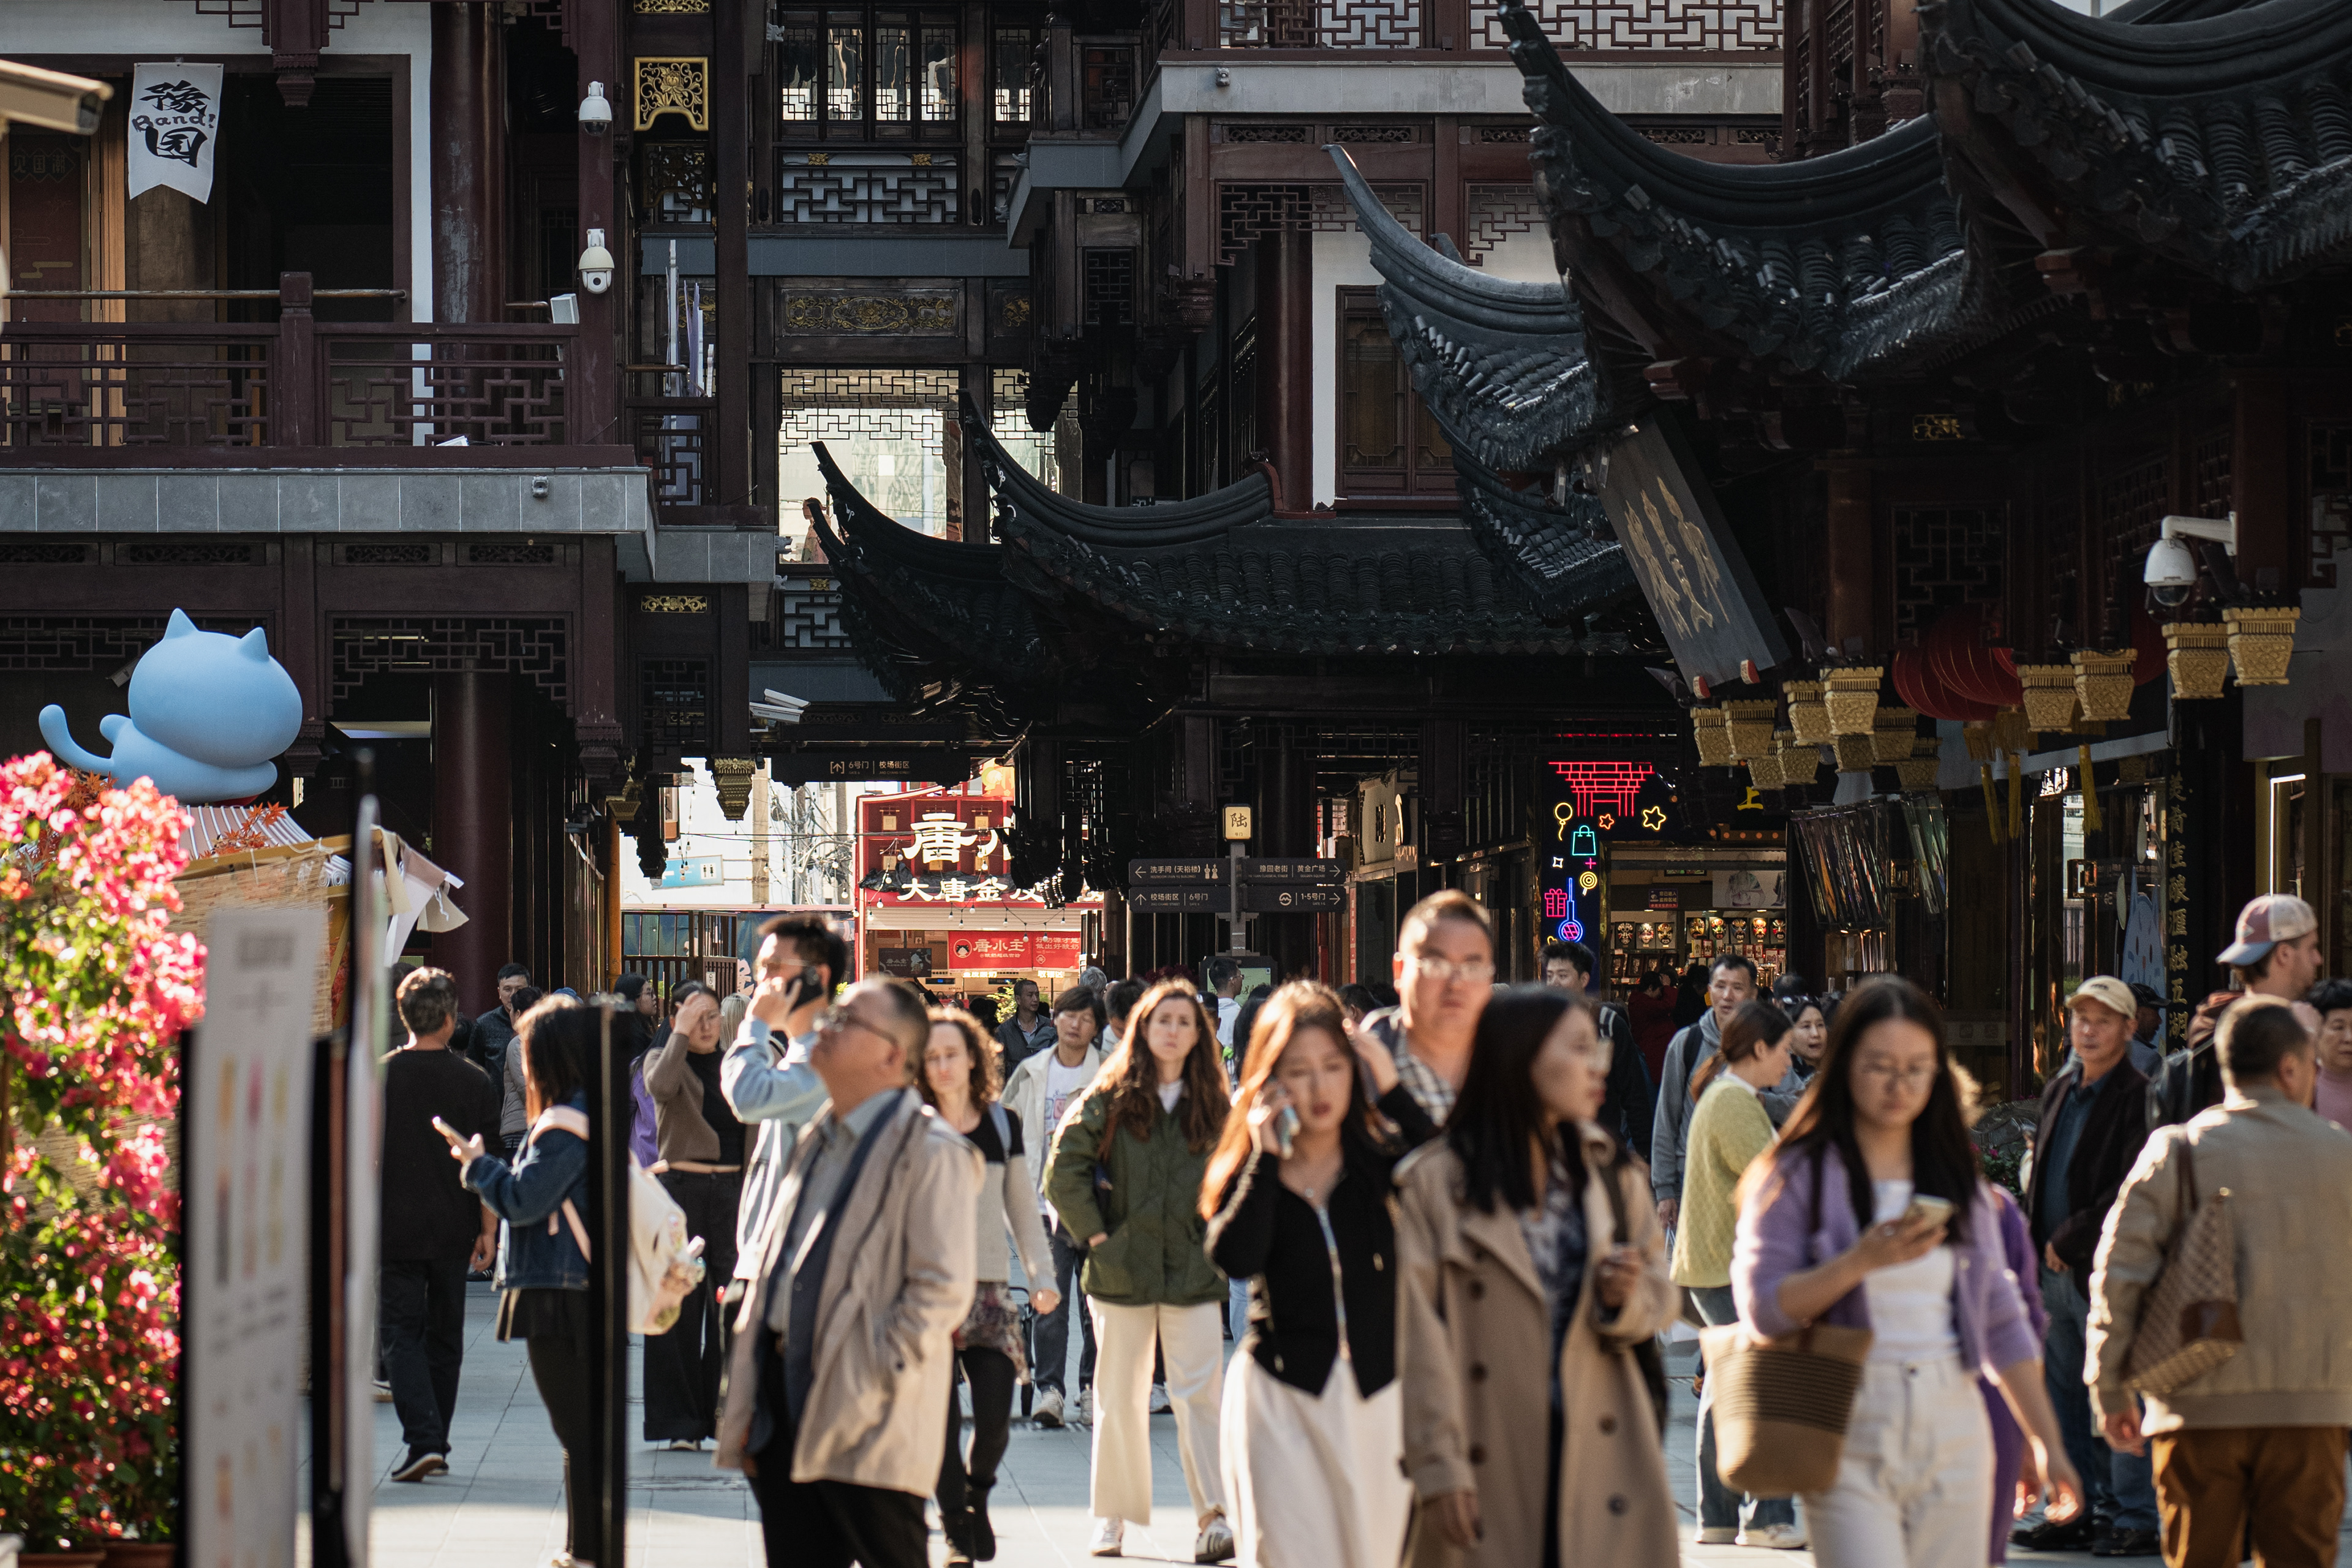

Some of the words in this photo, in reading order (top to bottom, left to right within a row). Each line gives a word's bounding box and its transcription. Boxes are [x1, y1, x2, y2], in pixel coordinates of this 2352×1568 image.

[848, 761, 869, 769] 6号门
[878, 761, 910, 769] 校场街区
[1736, 786, 1763, 811] 上
[1230, 812, 1247, 828] 陆
[1150, 865, 1172, 874] 洗手间
[1174, 864, 1201, 874] (天裕楼)
[1259, 864, 1288, 873] 豫园老街
[1297, 864, 1326, 873] 黄金广场
[973, 939, 1025, 952] 唐小主
